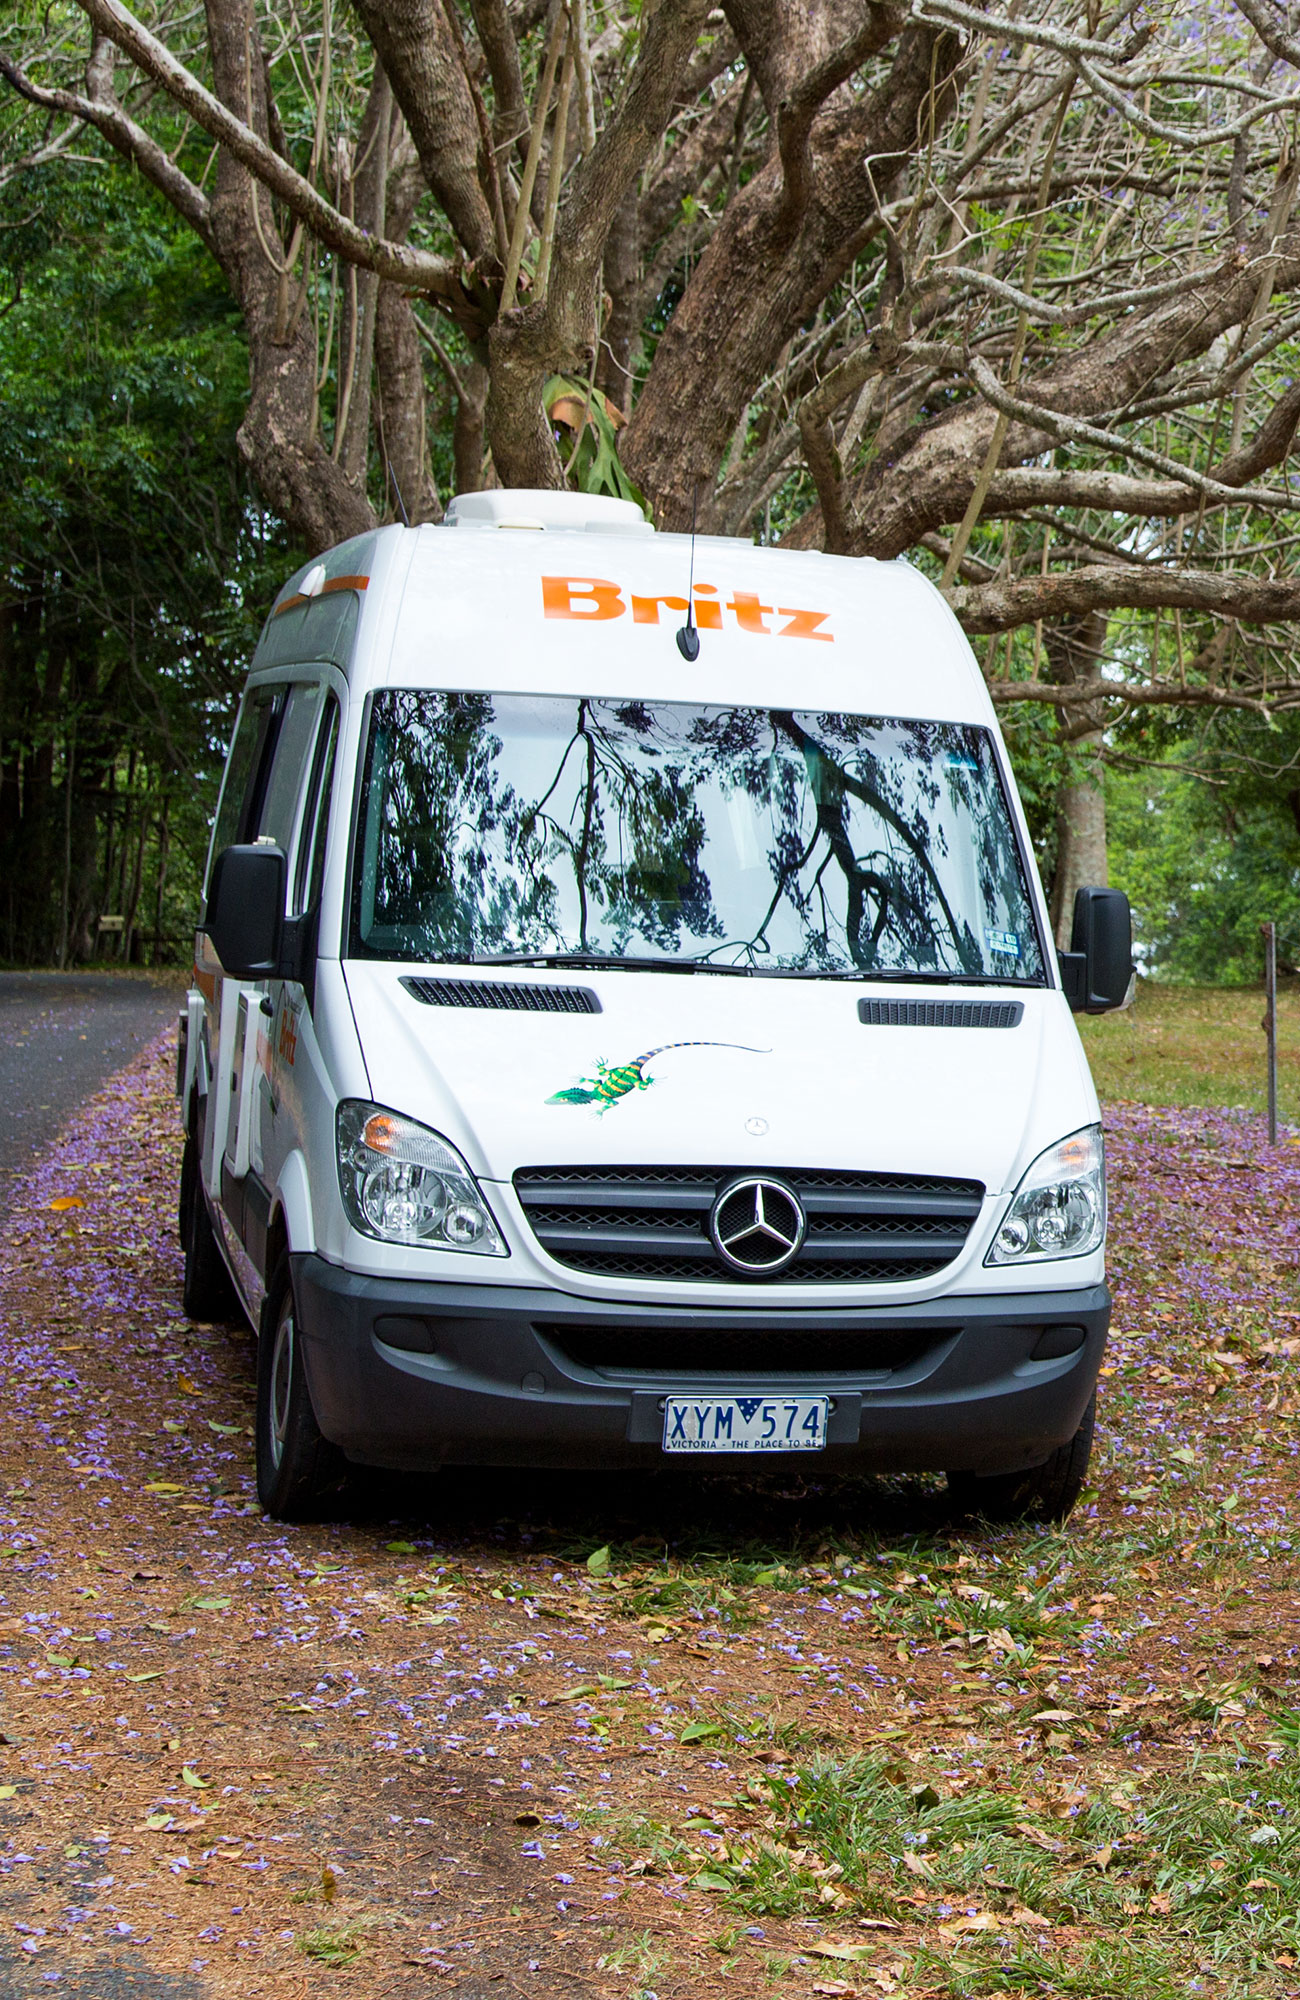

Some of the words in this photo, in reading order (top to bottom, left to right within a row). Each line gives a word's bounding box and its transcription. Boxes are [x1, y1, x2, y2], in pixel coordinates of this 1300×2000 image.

[541, 576, 835, 642] Britz
[671, 1406, 734, 1439] XYM
[761, 1406, 820, 1438] 574
[671, 1440, 717, 1449] VICTORIA
[731, 1440, 749, 1449] THE
[754, 1440, 783, 1448] PLACE
[788, 1440, 800, 1448] TO
[805, 1439, 818, 1448] BE
